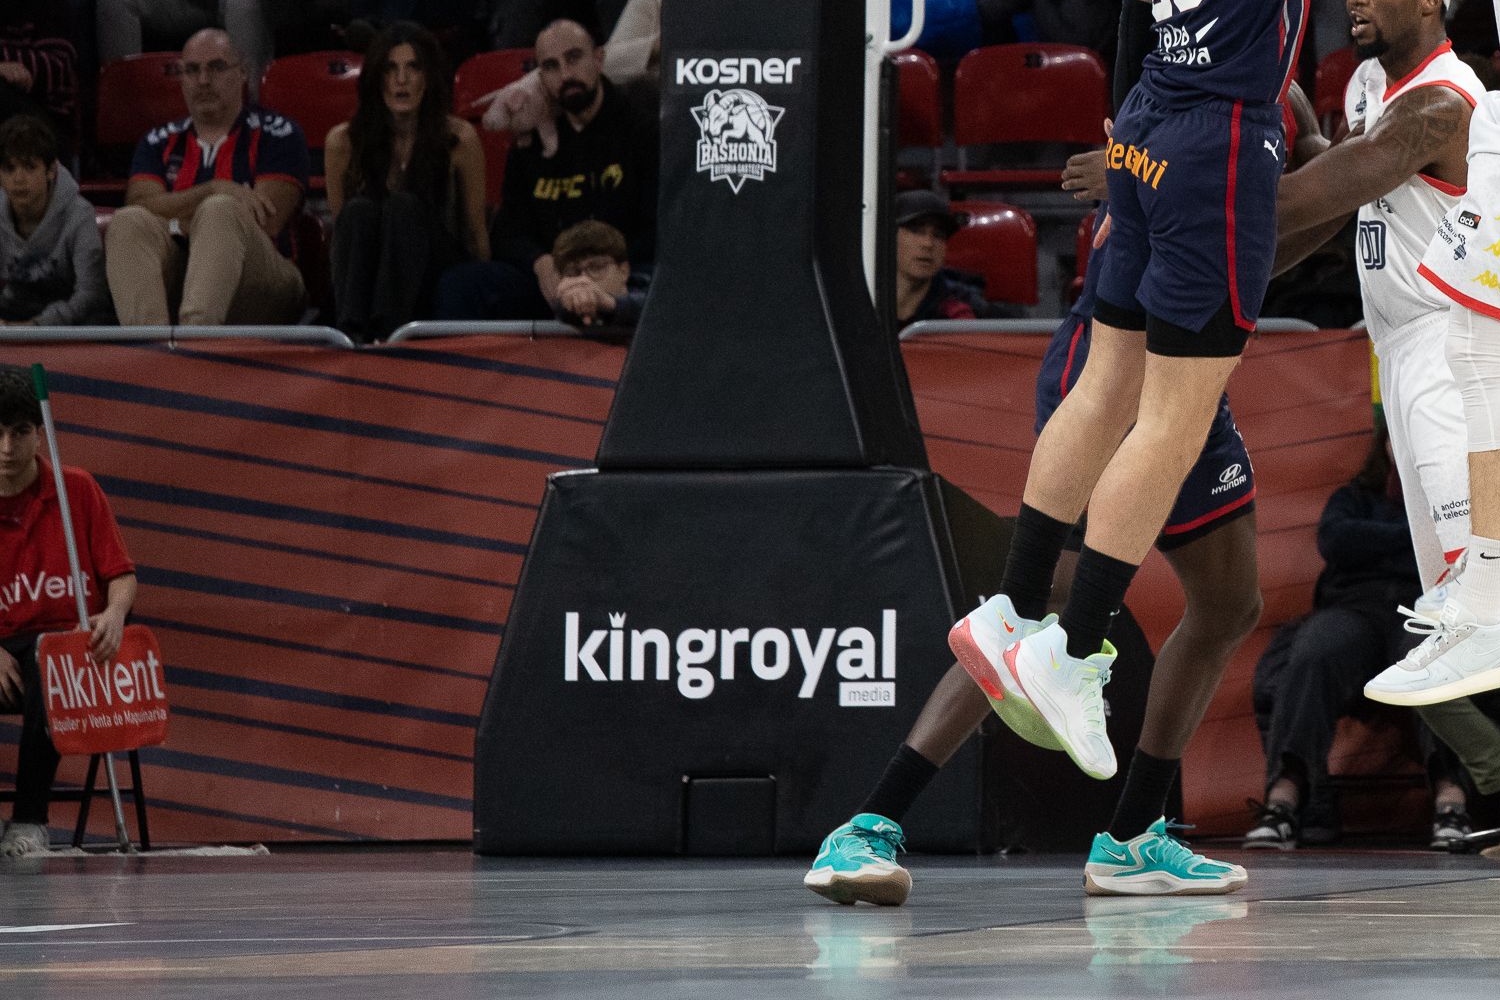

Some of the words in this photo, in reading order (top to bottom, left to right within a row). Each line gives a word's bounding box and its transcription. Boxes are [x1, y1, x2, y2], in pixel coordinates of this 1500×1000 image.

[533, 173, 586, 200] UFC
[1459, 215, 1476, 227] acb
[1211, 474, 1247, 495] HYUNDAI
[1443, 508, 1470, 520] teleco
[564, 608, 896, 699] kingroyal
[46, 649, 165, 709] AlkiVent
[847, 687, 892, 702] media
[88, 712, 113, 729] Venta
